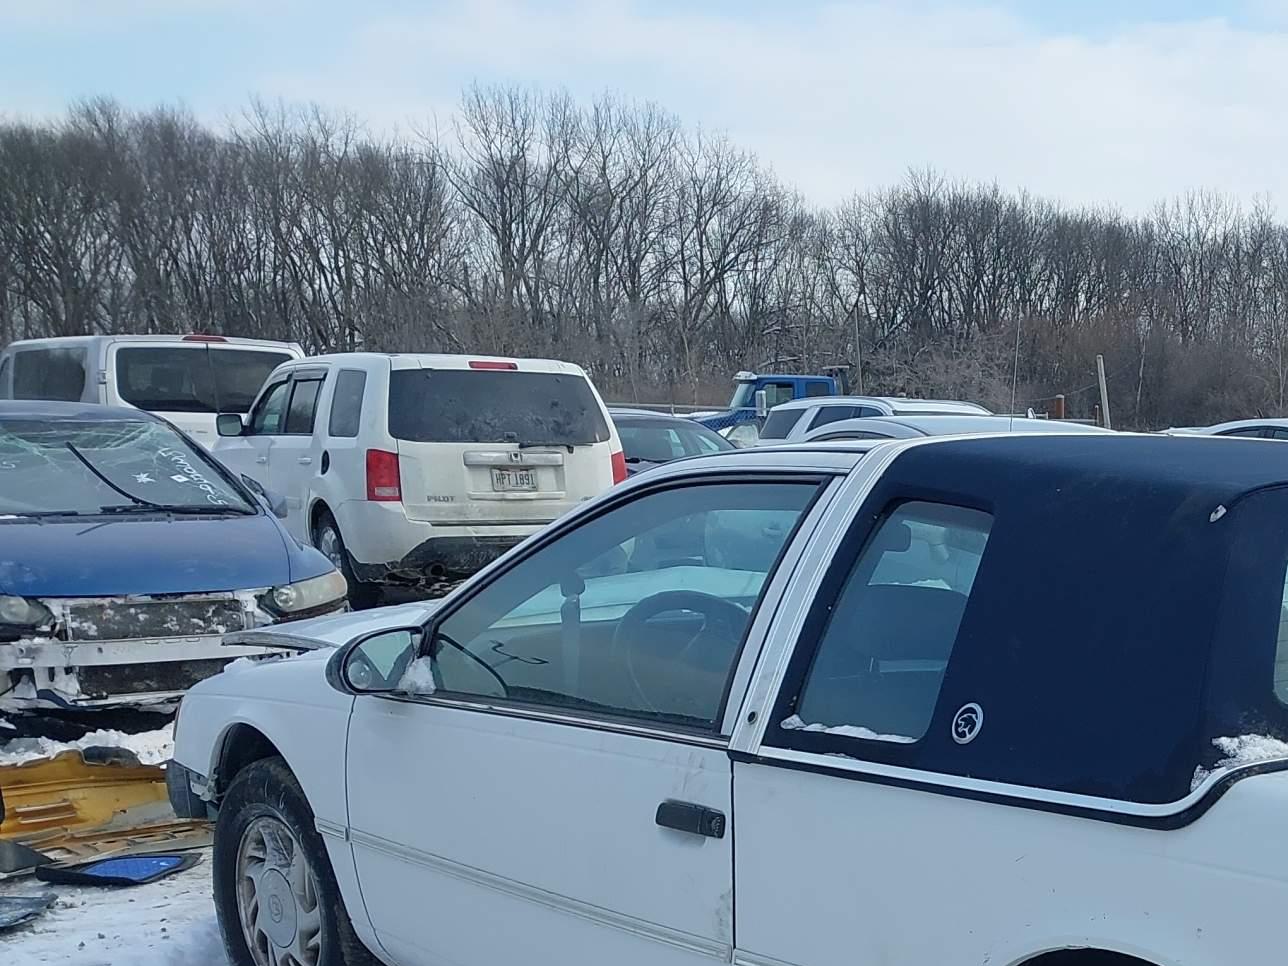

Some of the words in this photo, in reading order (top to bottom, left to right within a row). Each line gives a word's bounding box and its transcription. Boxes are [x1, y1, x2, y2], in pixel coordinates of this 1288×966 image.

[495, 472, 511, 486] HPT
[514, 471, 535, 486] 1891
[426, 495, 456, 503] PILOT
